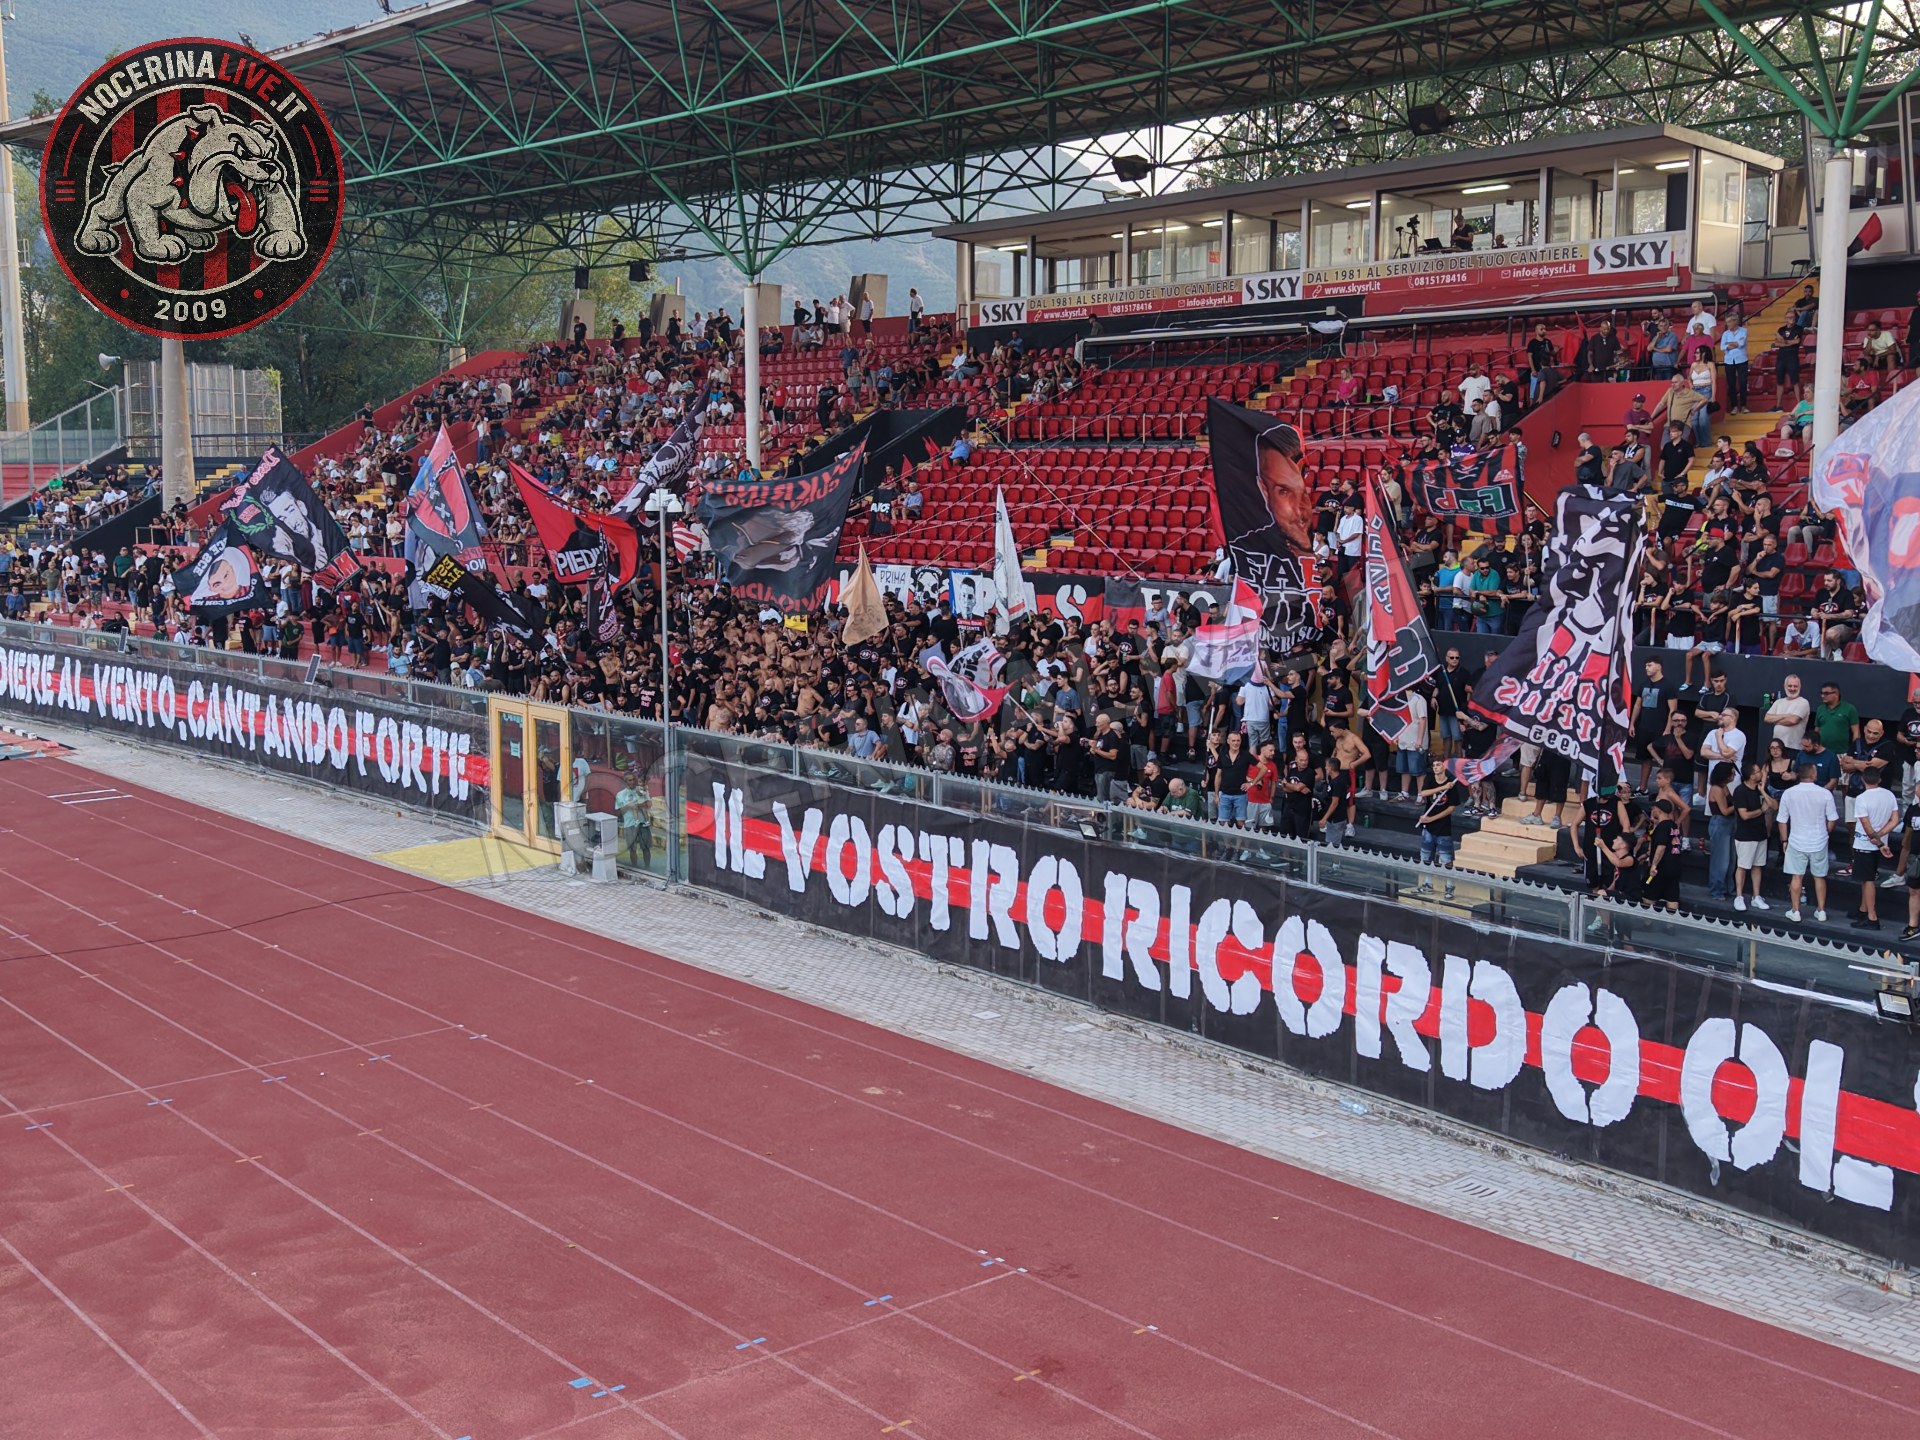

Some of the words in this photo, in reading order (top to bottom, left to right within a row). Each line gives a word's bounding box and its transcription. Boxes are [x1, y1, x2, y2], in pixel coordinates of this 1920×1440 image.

[1610, 240, 1668, 268] SKY
[1308, 271, 1329, 283] DAL
[1335, 269, 1361, 281] 1981
[1367, 267, 1381, 278] AL
[1387, 258, 1445, 276] SERVIZIO
[1450, 257, 1473, 270] DEL
[1478, 253, 1505, 267] TUO
[1512, 264, 1576, 279] info@skysrl.it
[1257, 276, 1301, 300] SKY
[1324, 281, 1381, 295] www.skysrl.it
[1414, 273, 1467, 286] 0815178416
[1030, 300, 1047, 309] DAL
[1052, 297, 1072, 307] 1981
[1076, 295, 1087, 305] AL
[1091, 290, 1135, 304] SERVIZIO
[1139, 288, 1156, 299] DEL
[1161, 286, 1180, 297] TUO
[1112, 302, 1153, 314] 0815178416
[1186, 295, 1234, 308] info@skysrl.it
[991, 302, 1025, 323] SKY
[1043, 307, 1088, 320] www.skysrl.it
[58, 656, 90, 713] AL
[355, 709, 471, 801] FORTE
[712, 781, 766, 879] IL
[772, 801, 1083, 963] VOSTRO
[1102, 871, 1640, 1128] RICORDO
[1680, 1017, 1920, 1211] OL
